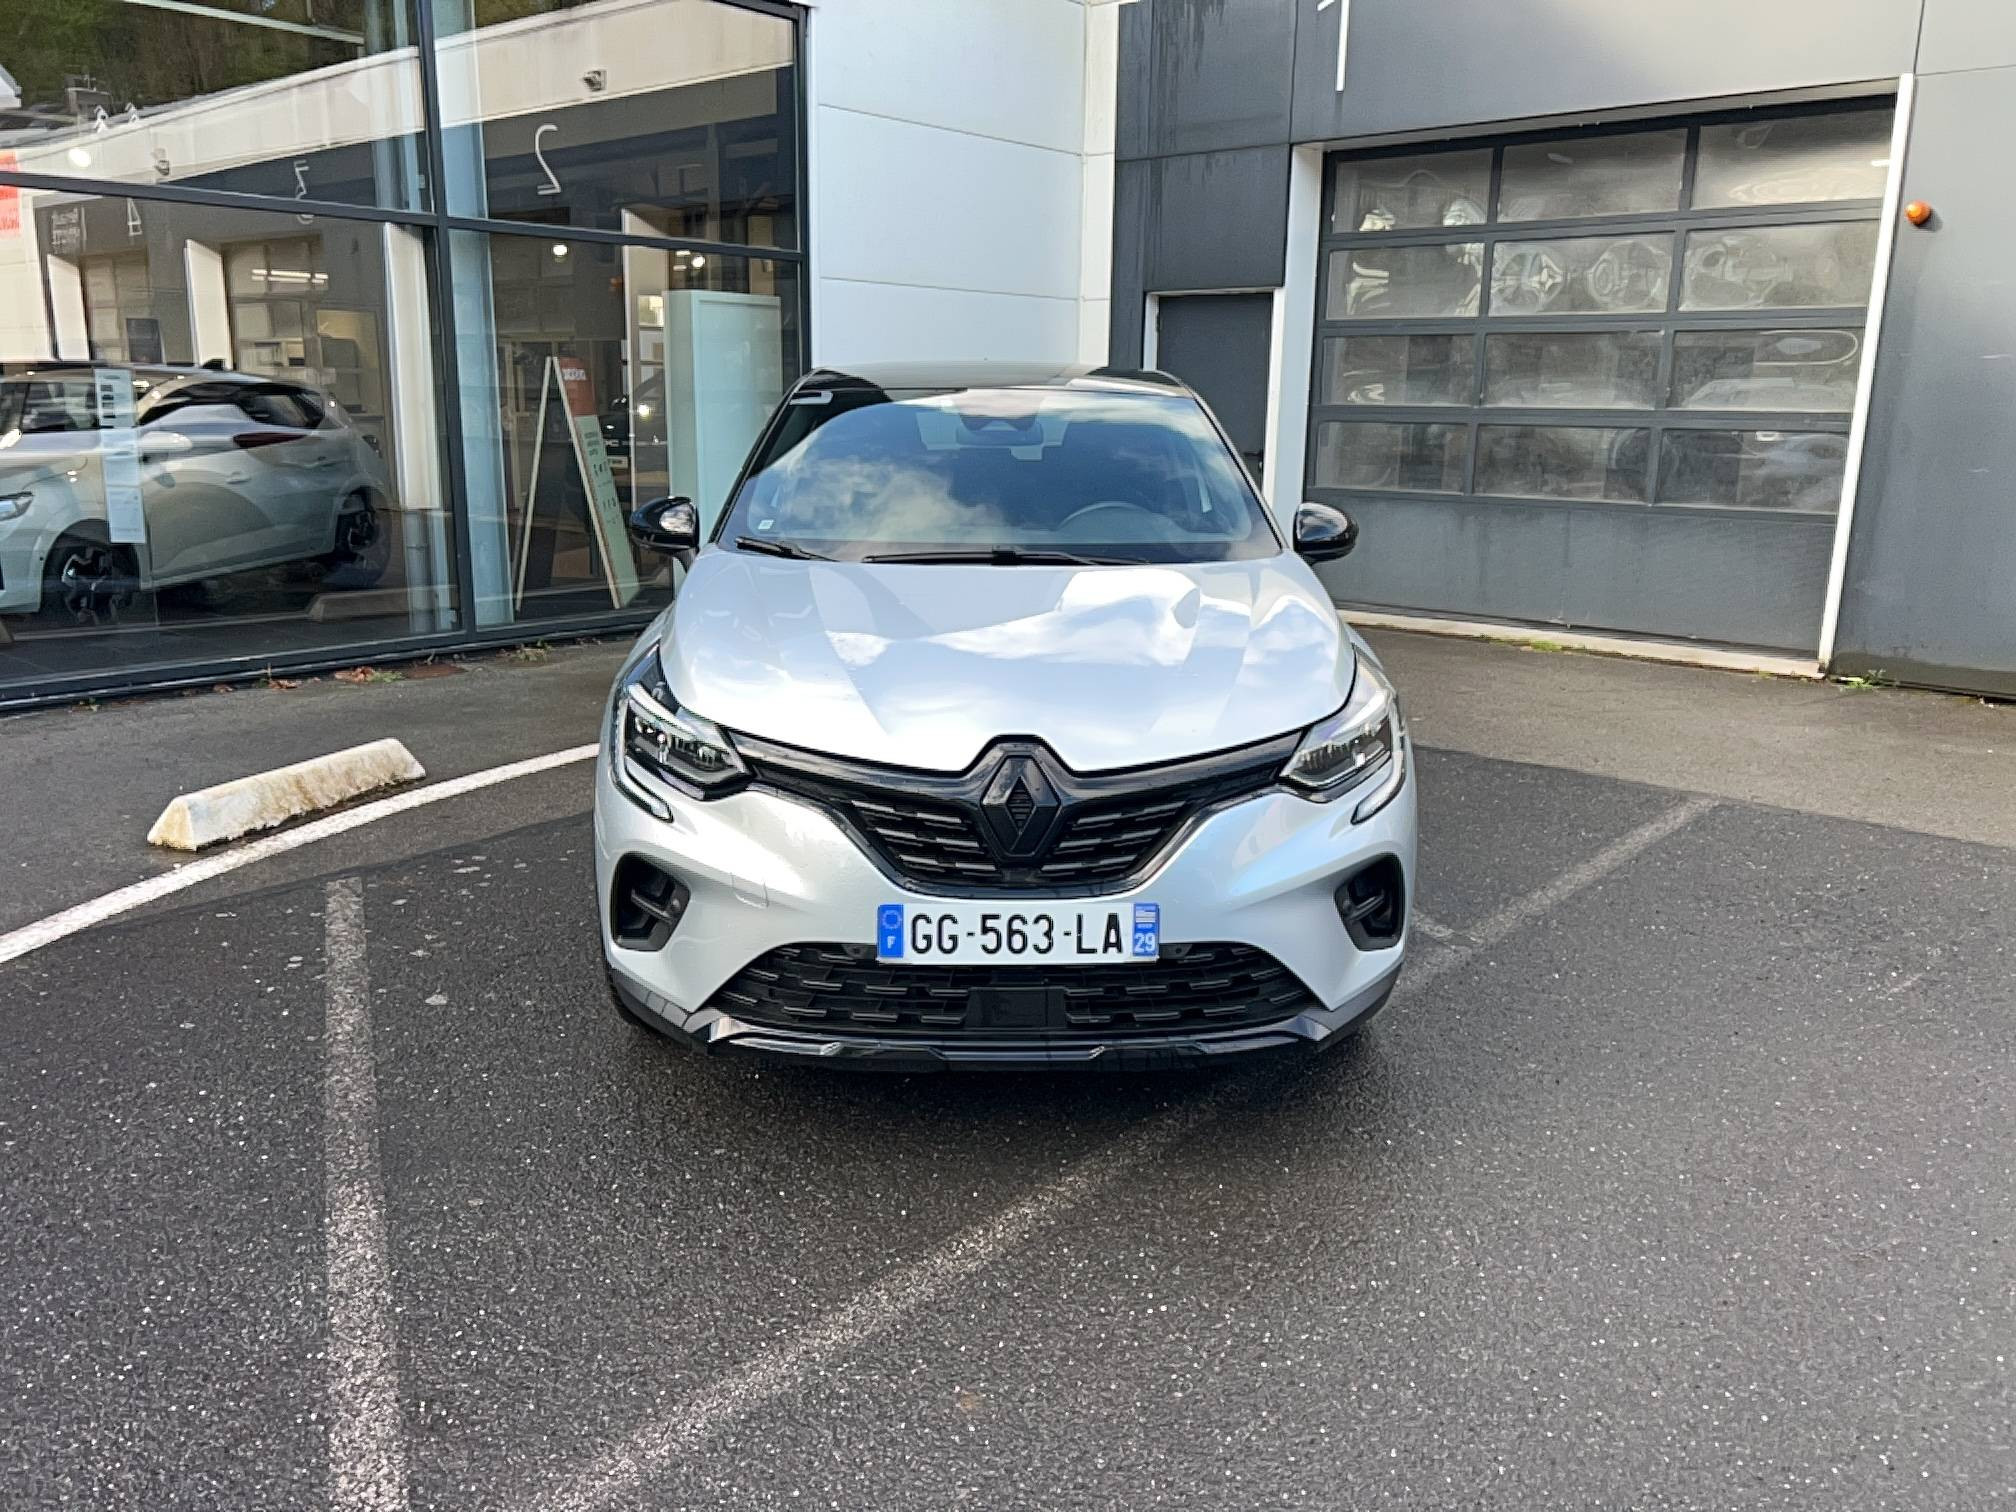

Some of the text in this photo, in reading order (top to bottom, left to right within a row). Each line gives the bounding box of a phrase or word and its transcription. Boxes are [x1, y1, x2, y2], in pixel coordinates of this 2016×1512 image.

[1316, 0, 1350, 92] 1
[886, 935, 896, 949] F
[911, 912, 1123, 955] GG-563-LA
[1134, 932, 1156, 953] 29
